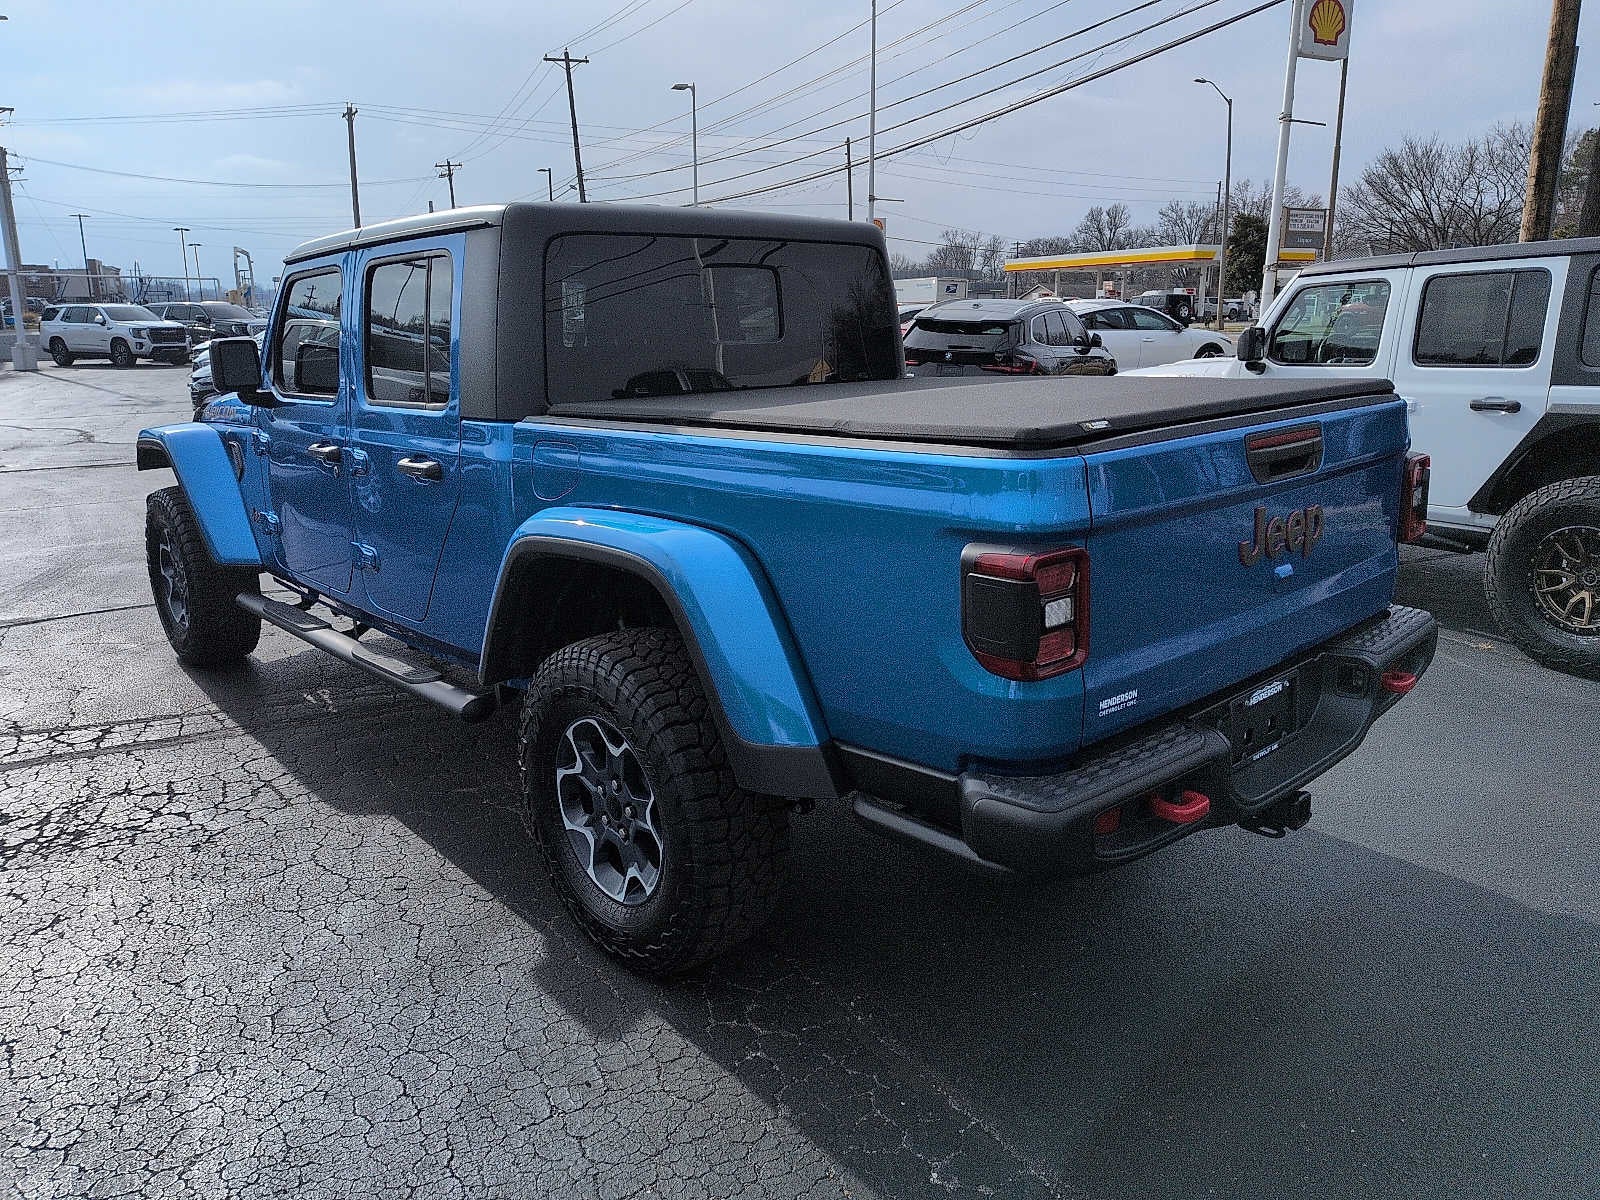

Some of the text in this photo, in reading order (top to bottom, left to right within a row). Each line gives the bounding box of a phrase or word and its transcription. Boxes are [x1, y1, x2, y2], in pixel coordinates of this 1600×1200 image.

[1238, 504, 1323, 567] Jeep
[1100, 689, 1138, 710] HENDERSON
[1249, 684, 1282, 705] HENDERSON
[1099, 699, 1137, 717] CHEVROLET GMC
